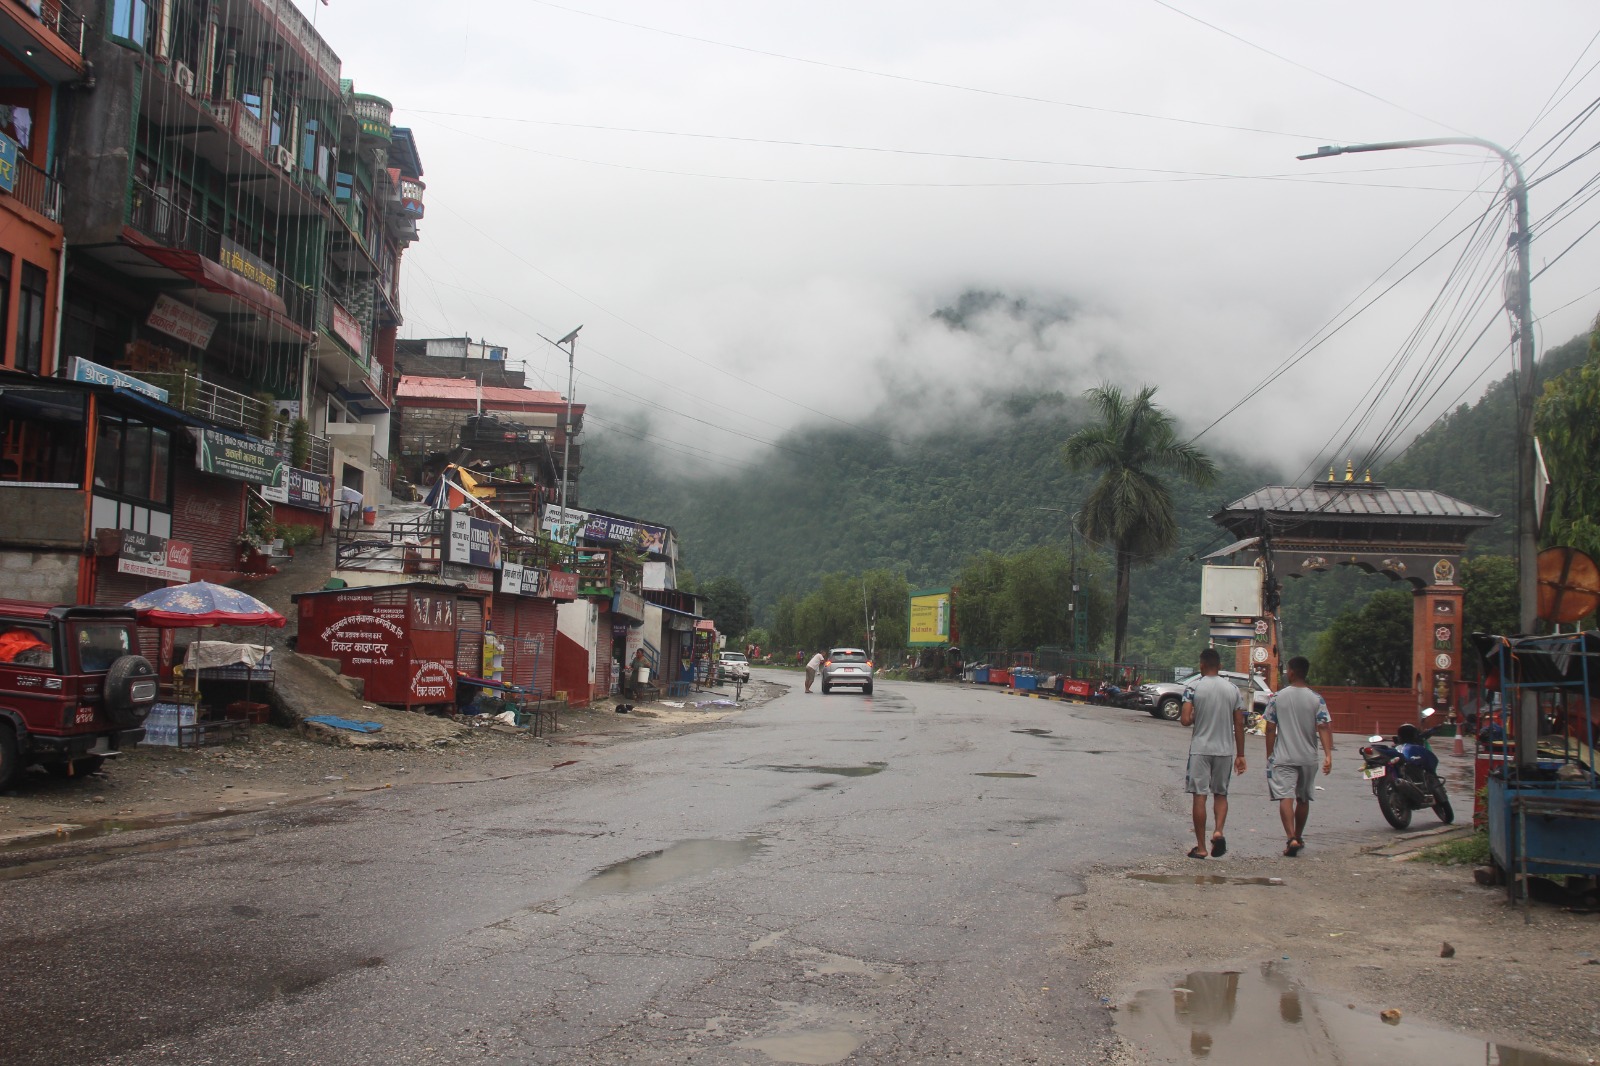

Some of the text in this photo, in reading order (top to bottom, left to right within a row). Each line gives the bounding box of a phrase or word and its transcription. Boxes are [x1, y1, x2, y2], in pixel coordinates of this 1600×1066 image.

[197, 334, 208, 348] घर
[257, 456, 265, 467] घर
[302, 477, 320, 494] XTREME
[125, 533, 146, 546] Just Add
[470, 527, 489, 545] XTREME
[123, 543, 136, 554] Coke
[331, 638, 388, 656] टिकट काउण्टर
